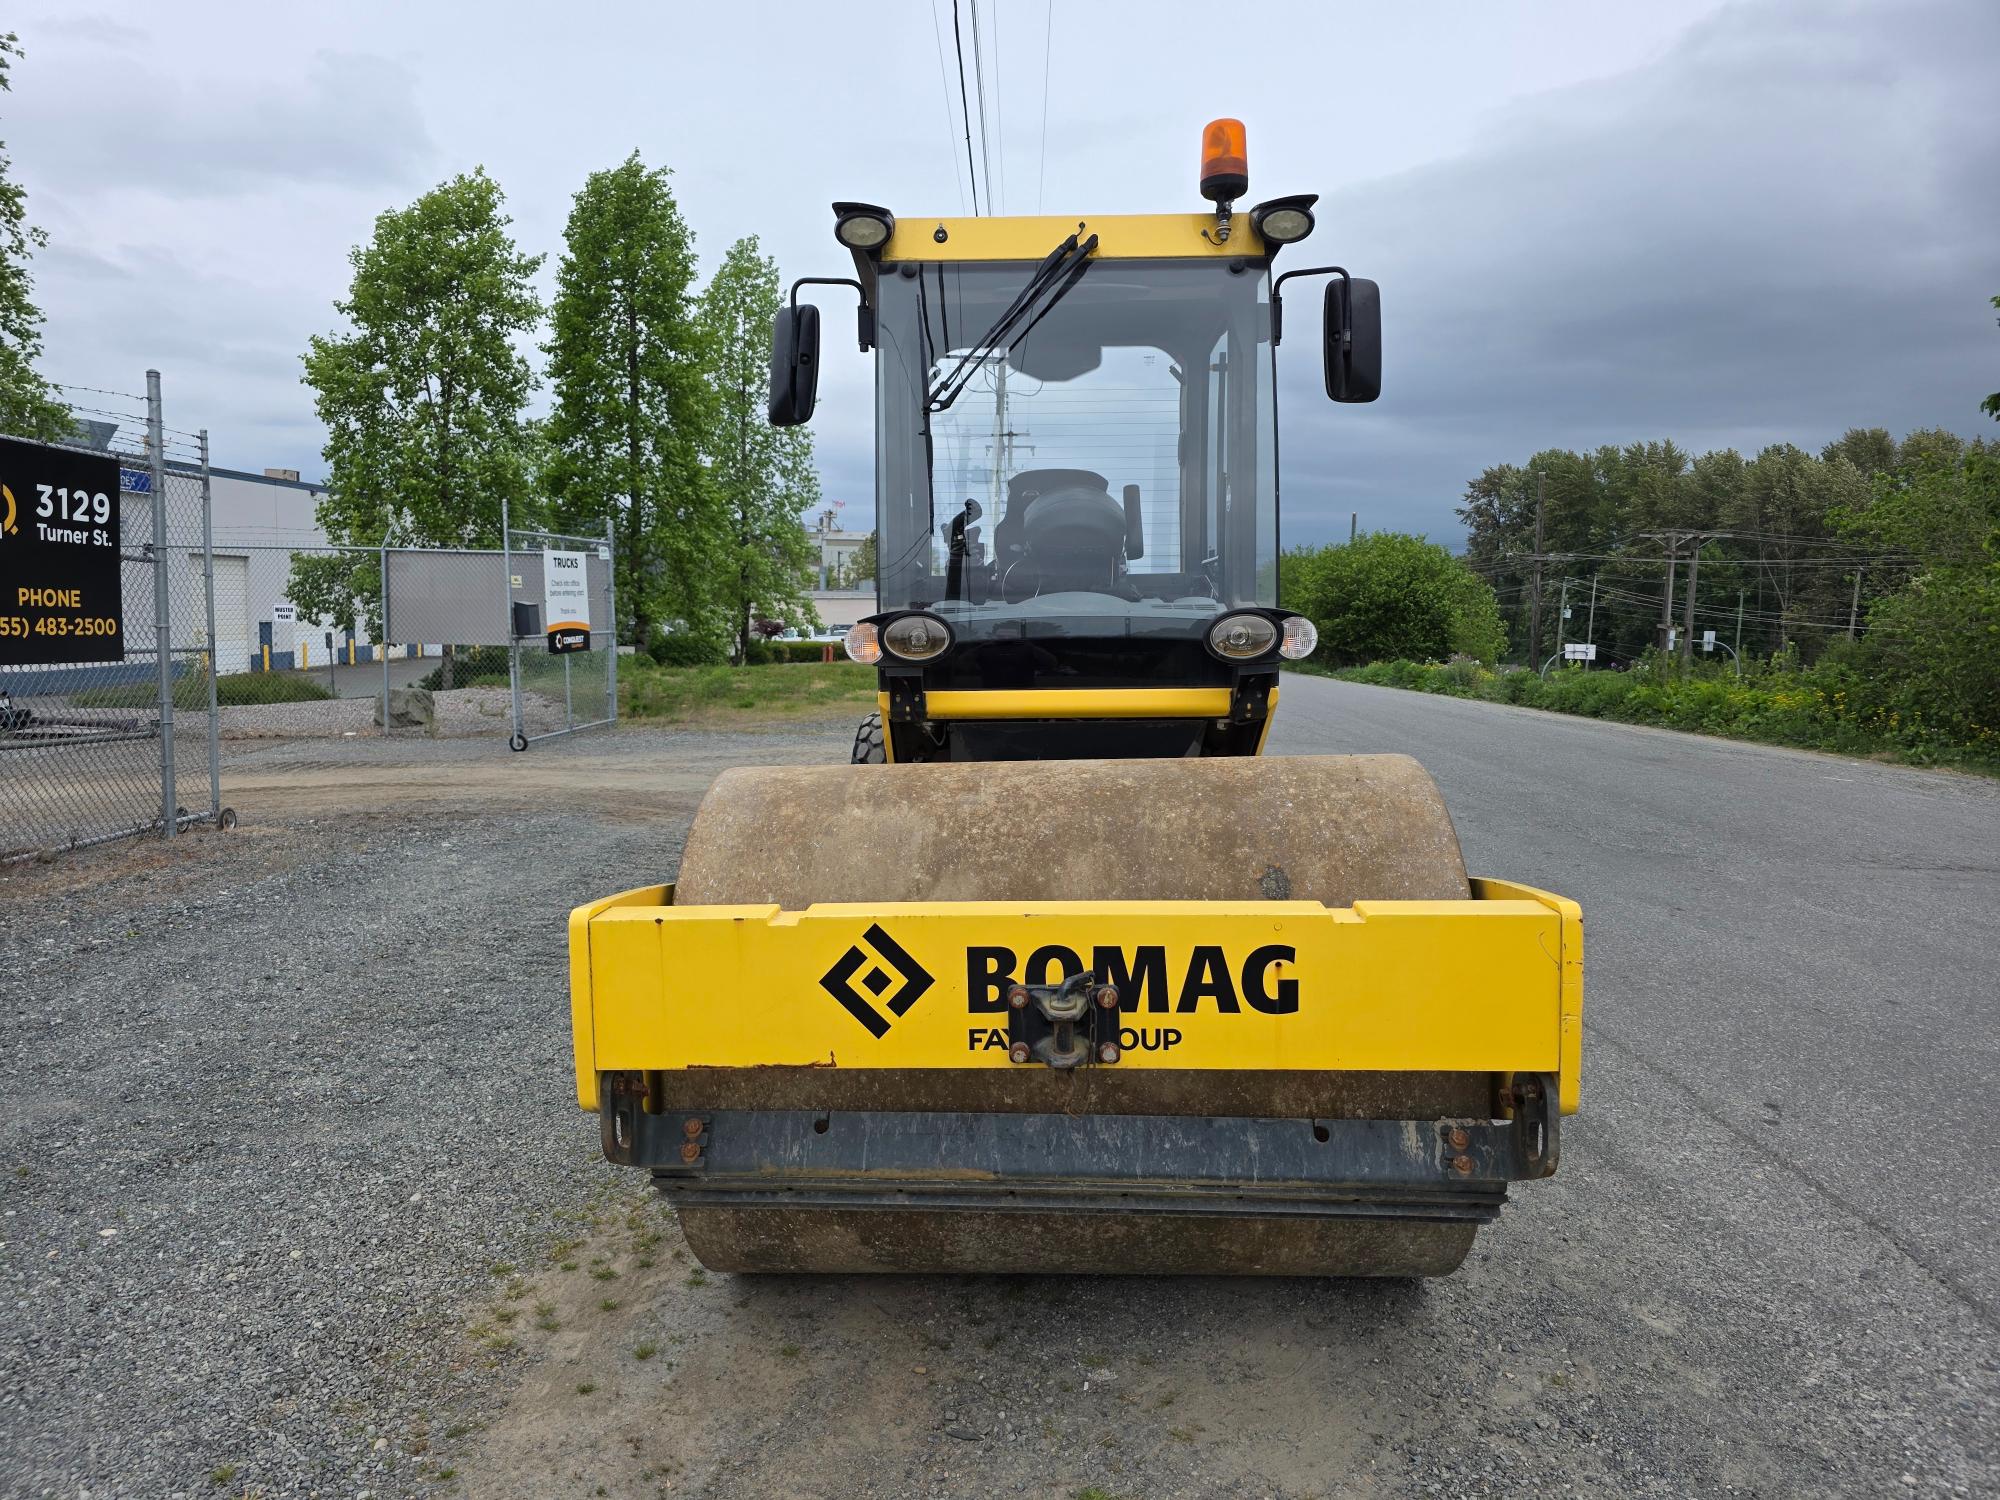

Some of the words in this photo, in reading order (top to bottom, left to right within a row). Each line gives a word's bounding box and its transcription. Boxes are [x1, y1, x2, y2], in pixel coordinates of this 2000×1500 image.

[36, 484, 110, 524] 3129
[37, 523, 89, 545] Turner
[93, 529, 112, 547] St.
[553, 557, 578, 568] TRUCKS
[18, 588, 81, 607] PHONE
[0, 617, 29, 639] 55)
[35, 617, 116, 636] 483-2500
